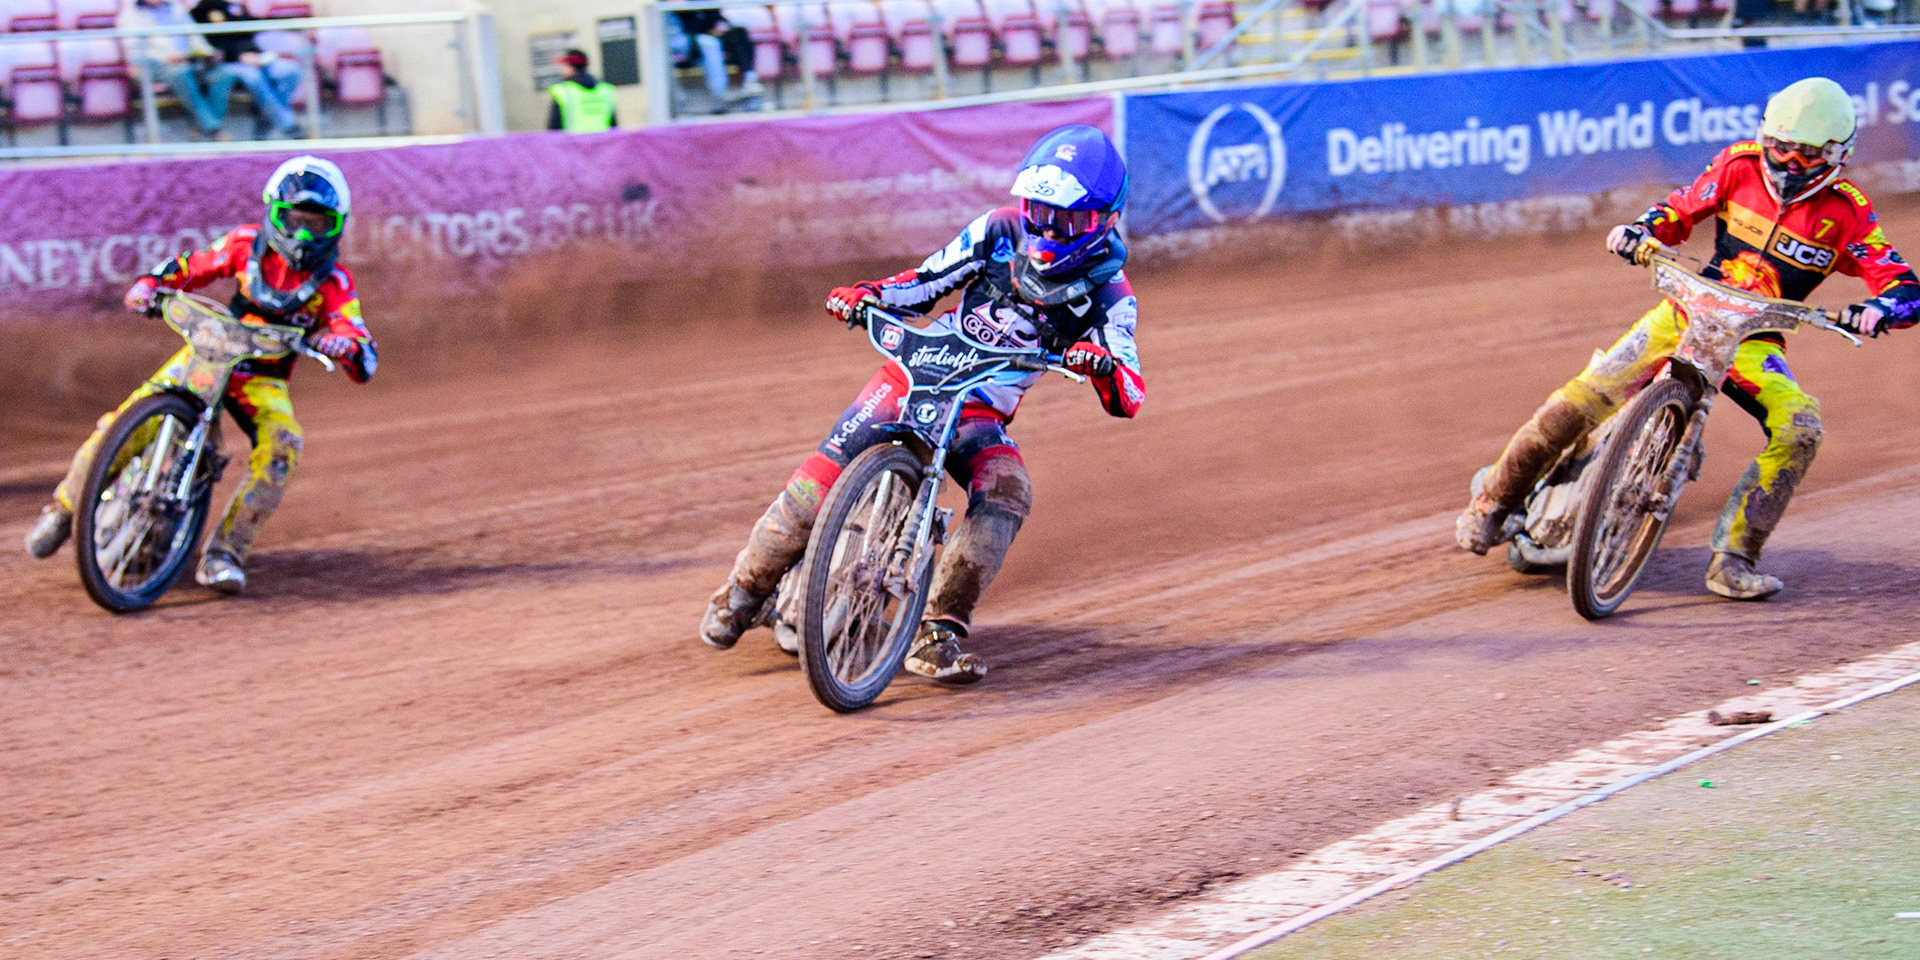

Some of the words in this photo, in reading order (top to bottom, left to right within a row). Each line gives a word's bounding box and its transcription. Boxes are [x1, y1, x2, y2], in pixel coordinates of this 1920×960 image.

[1325, 115, 1531, 176] Delivering
[1537, 100, 1655, 158] World
[1661, 96, 1760, 146] Class
[1815, 218, 1834, 239] 7
[1775, 238, 1834, 267] JCB
